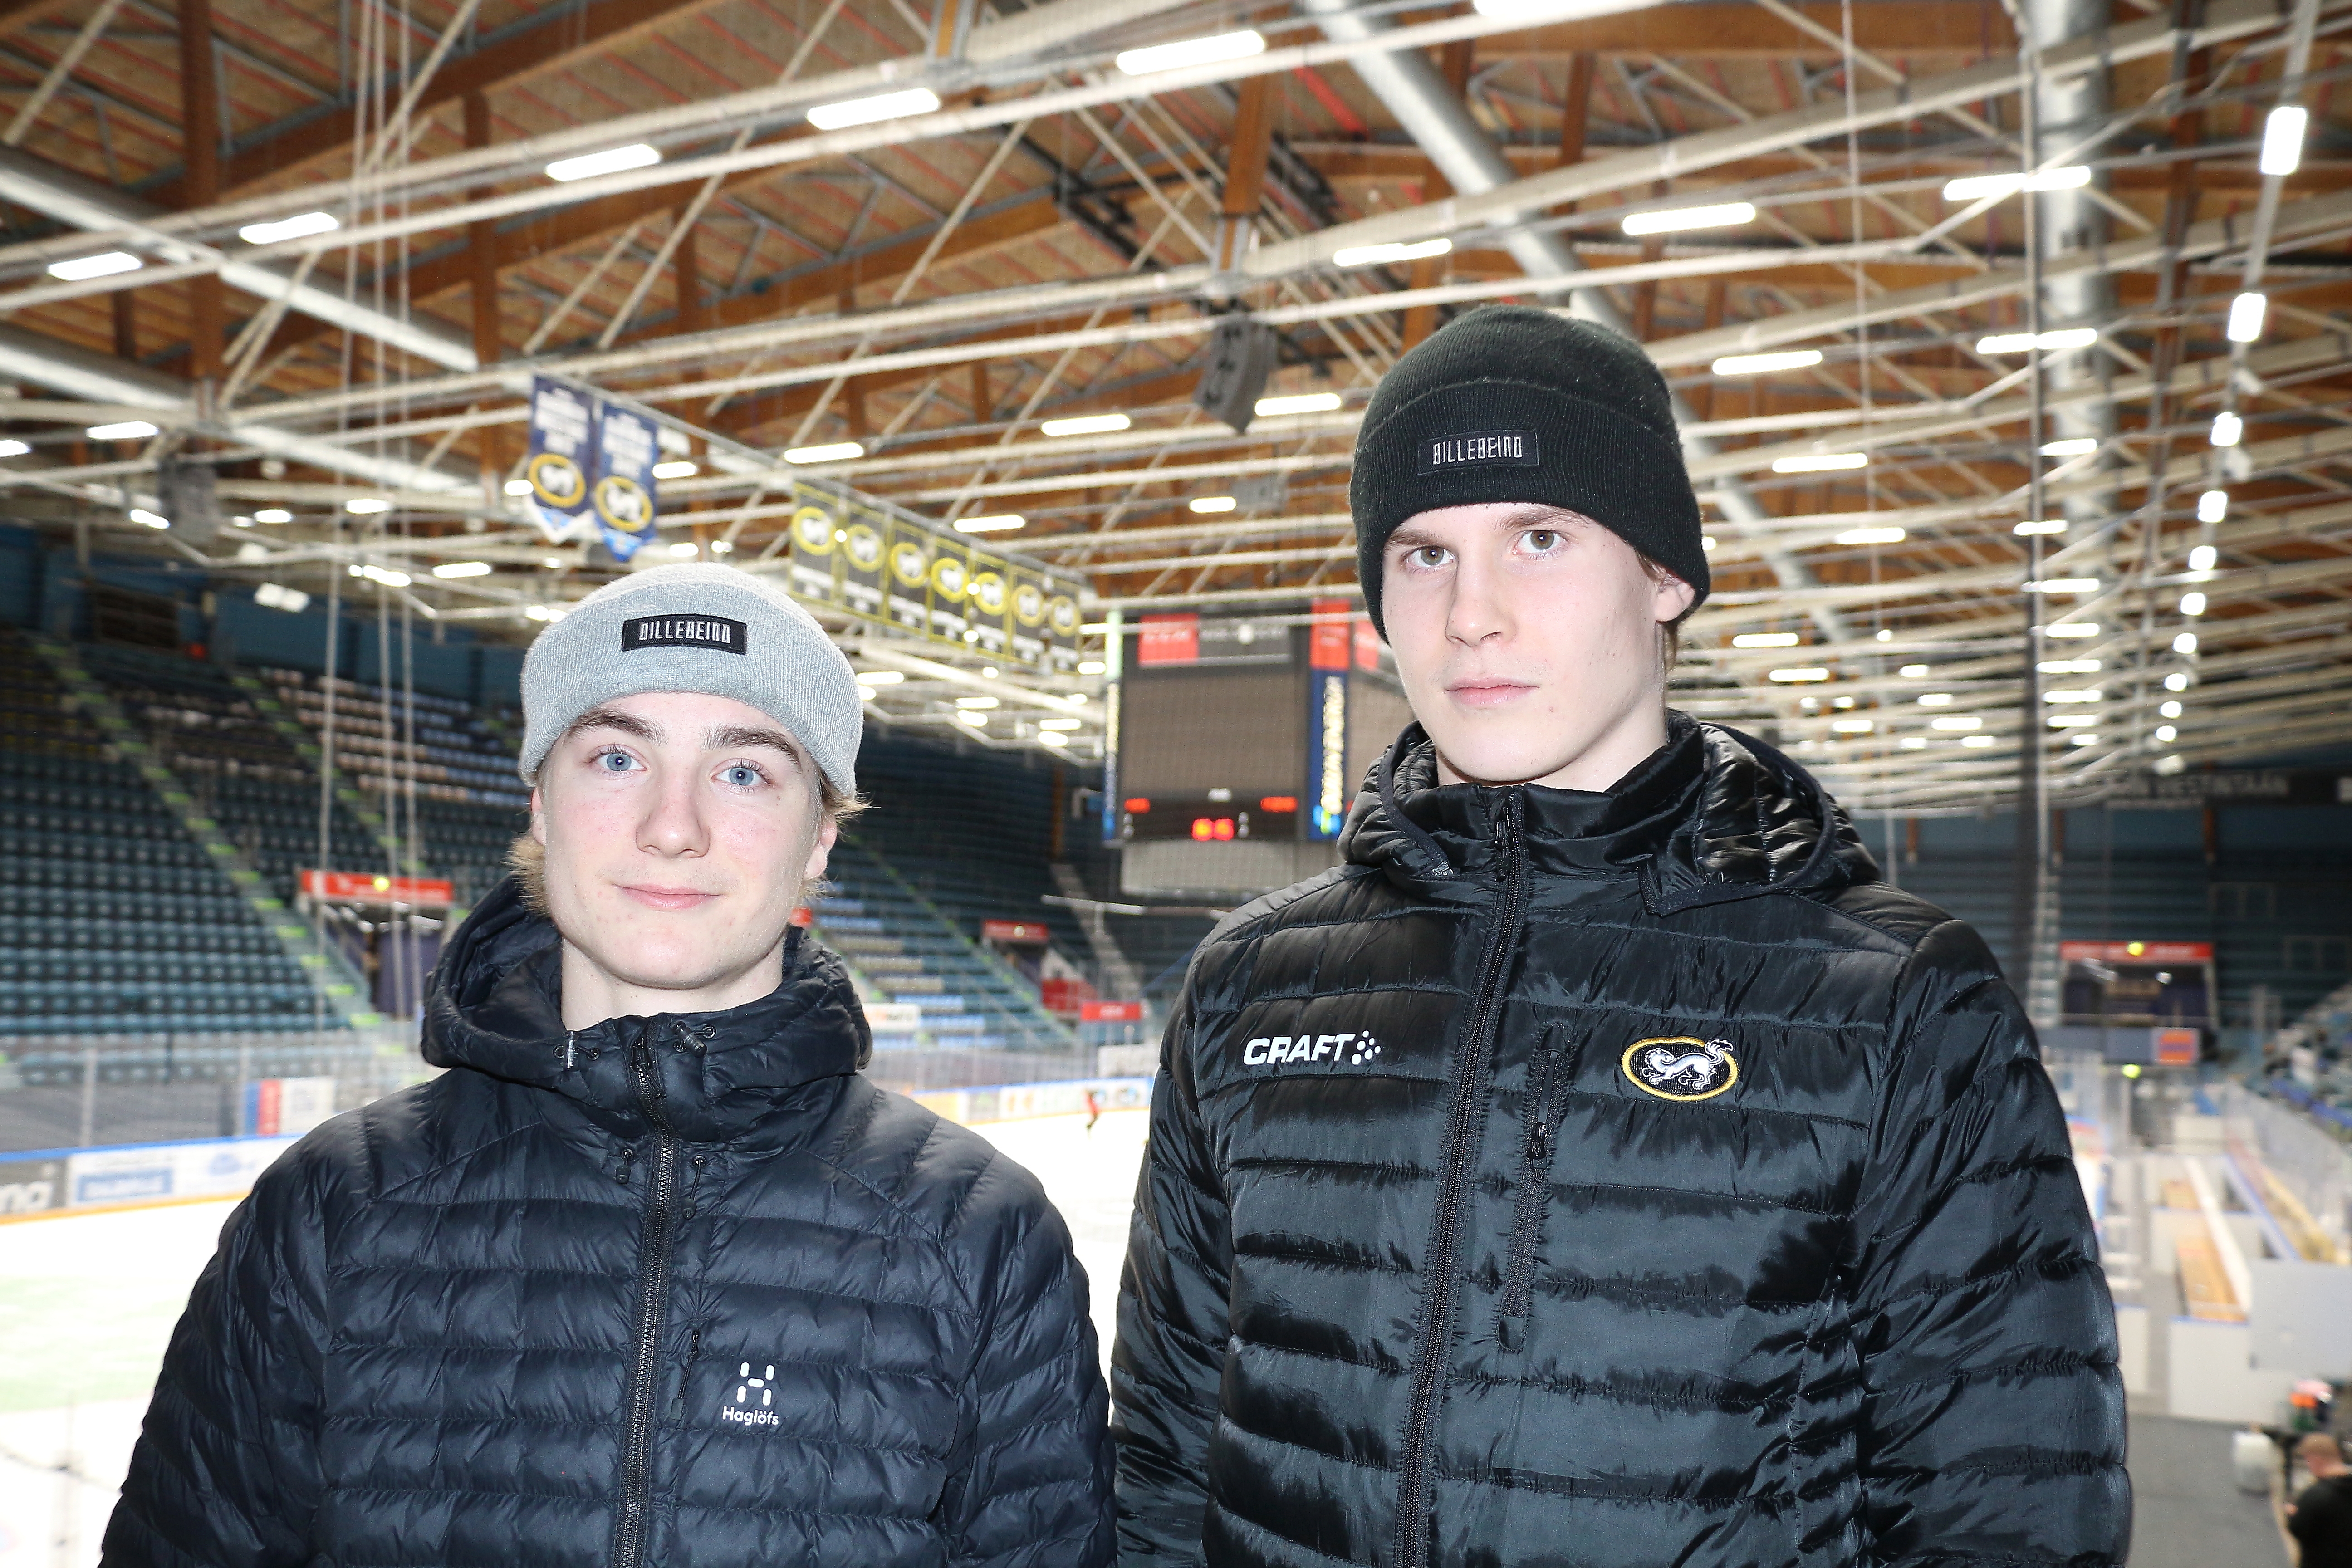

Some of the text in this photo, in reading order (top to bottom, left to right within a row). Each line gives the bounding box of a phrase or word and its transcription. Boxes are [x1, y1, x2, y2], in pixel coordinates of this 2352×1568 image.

[1433, 436, 1523, 465] BILLEBEINO
[638, 620, 731, 644] BILLEBEINO
[1243, 1034, 1357, 1065] CRAFT
[722, 1406, 779, 1426] Haglöfs
